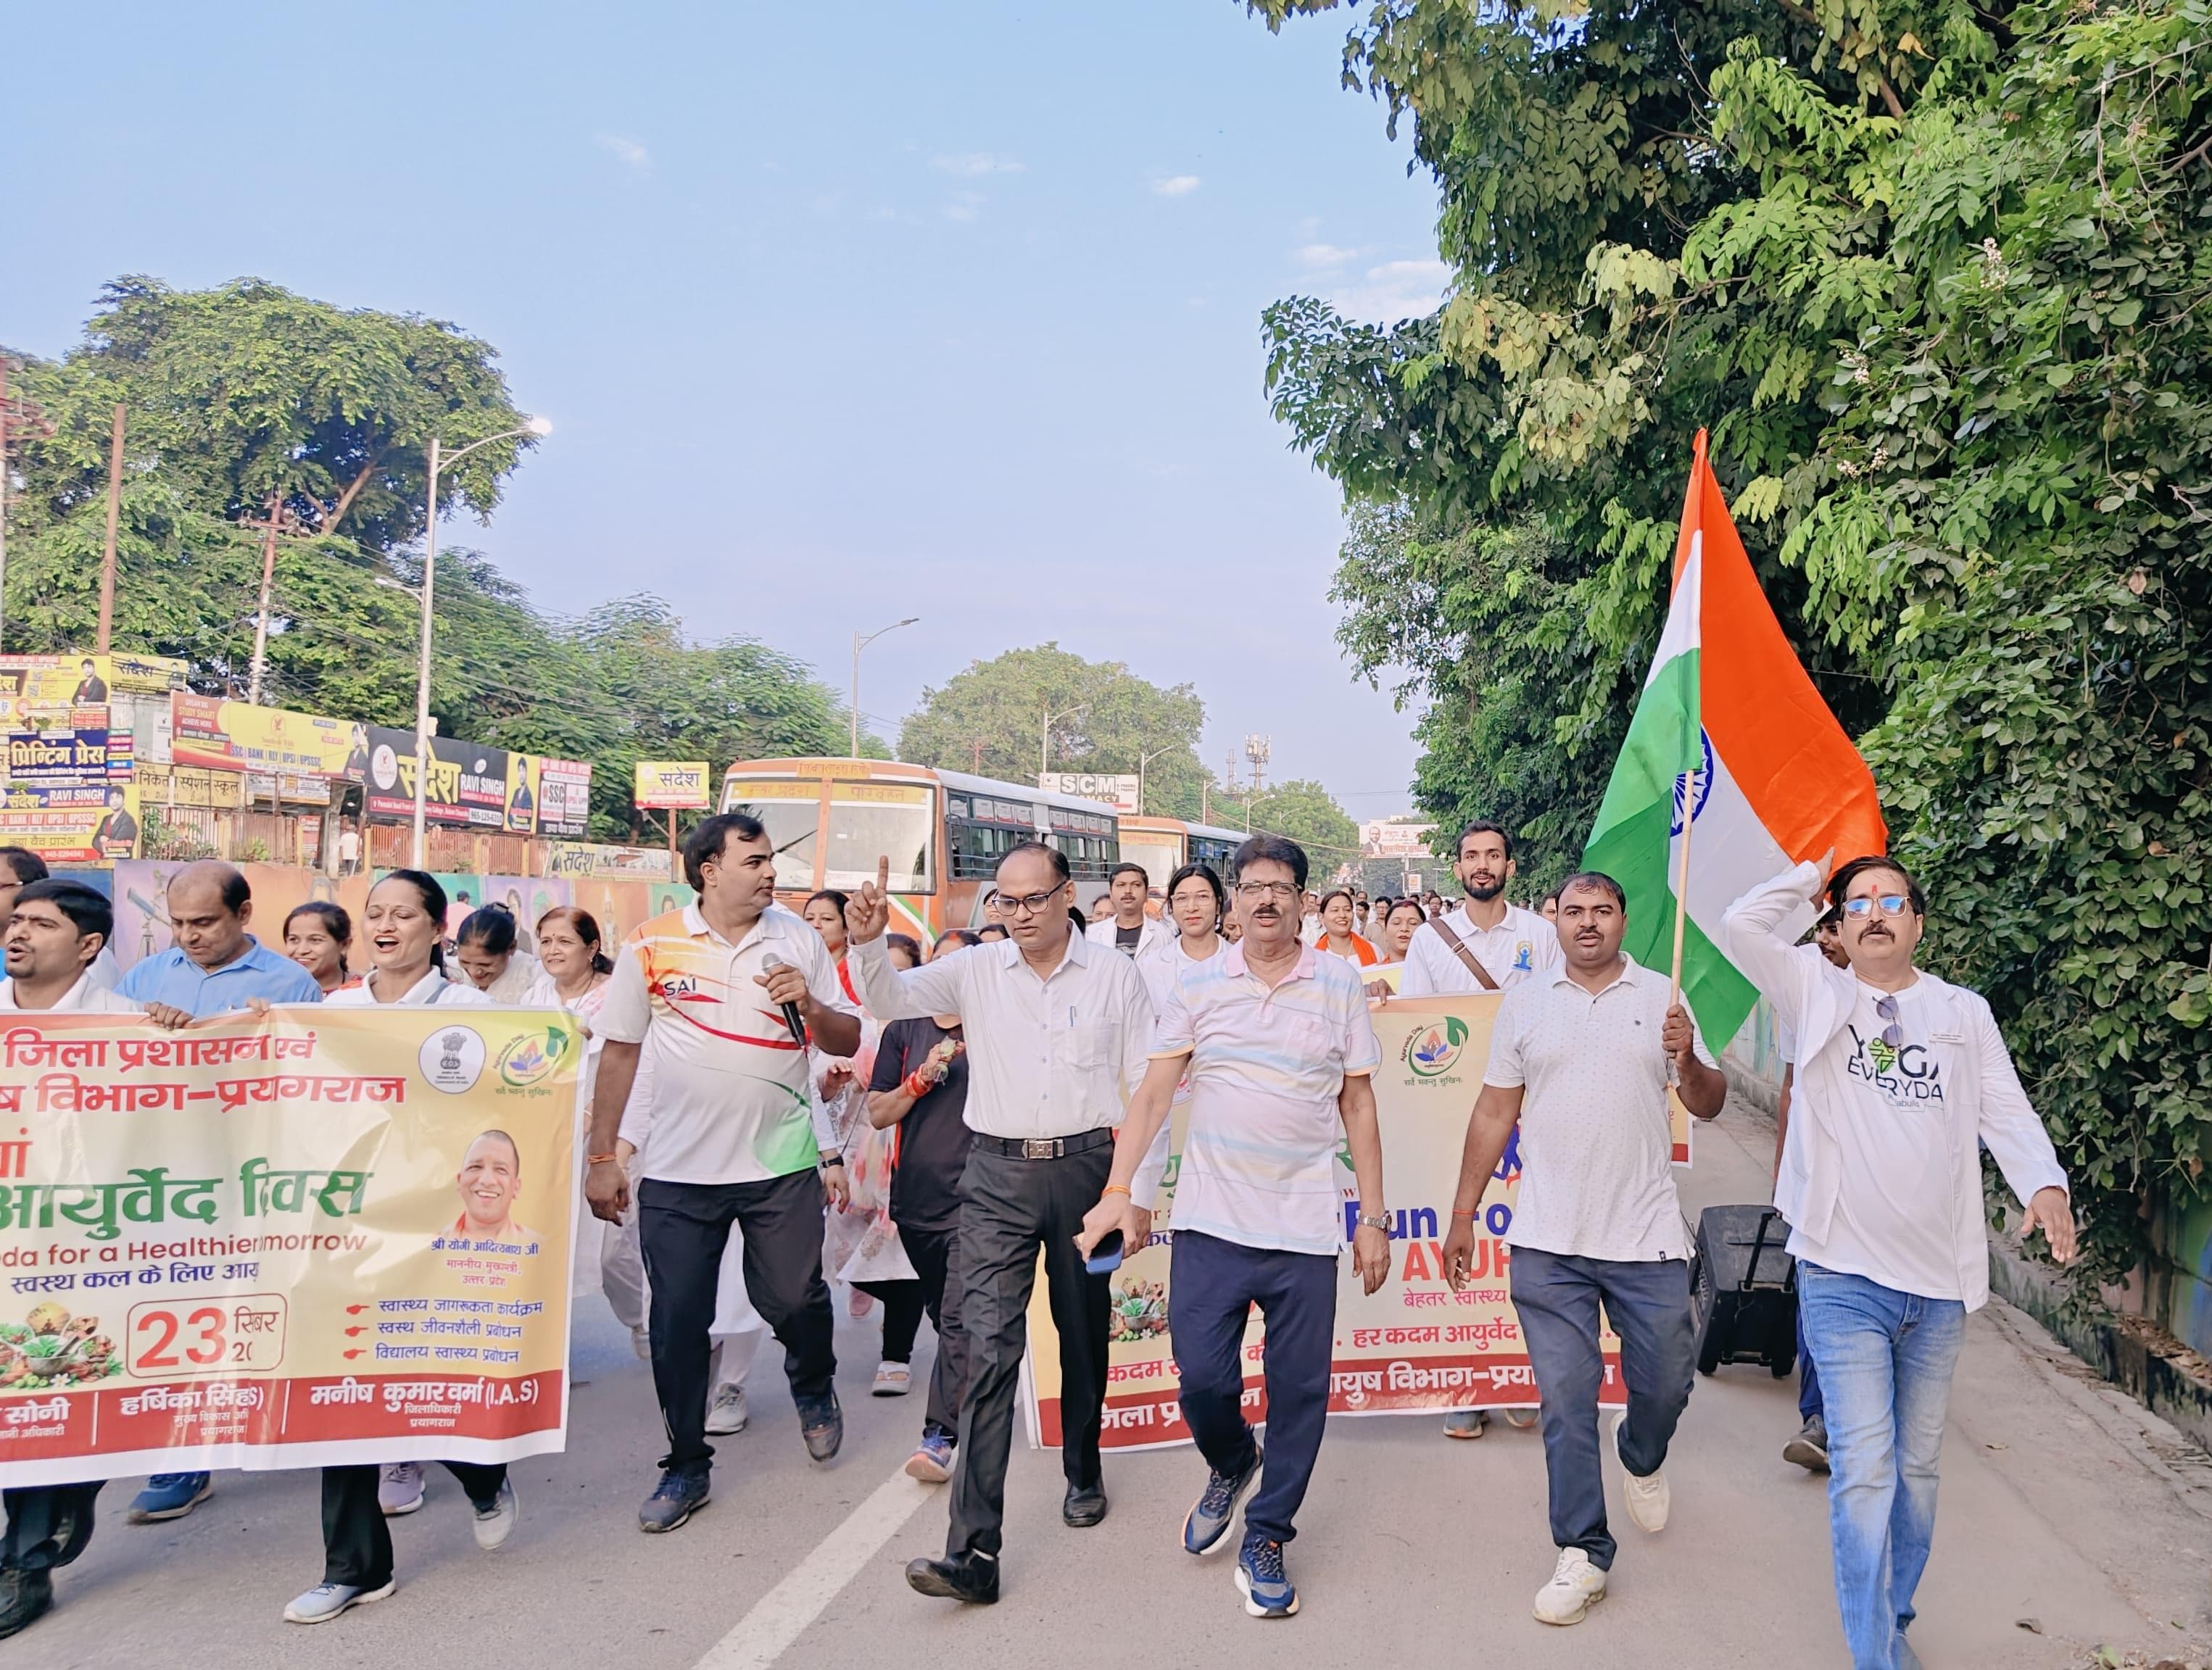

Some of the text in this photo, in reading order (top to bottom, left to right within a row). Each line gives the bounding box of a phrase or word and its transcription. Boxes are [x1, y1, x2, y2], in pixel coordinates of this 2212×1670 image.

[178, 707, 215, 720] STUDY SMART
[75, 739, 107, 765] प्रेस
[231, 745, 244, 757] SSC
[248, 747, 265, 760] BANK
[181, 773, 211, 791] स्पेशल
[214, 780, 239, 797] स्कूल
[460, 773, 505, 797] RAVI SINGH
[658, 766, 700, 787] संदेश
[1061, 775, 1115, 794] SCM
[49, 789, 105, 801] RAVI SINGH
[549, 784, 564, 803] SSC
[563, 846, 595, 873] संदेश
[664, 978, 696, 997] SAI
[4, 1027, 317, 1073] जिला प्रशासन एवं
[1847, 1055, 1944, 1102] EVERYDA
[49, 1243, 91, 1266] for
[99, 1245, 117, 1263] a
[128, 1234, 258, 1261] Healthier
[259, 1233, 368, 1252] morrow
[448, 1238, 471, 1251] योगी
[525, 1242, 539, 1255] जी
[447, 1258, 481, 1269] माननीय
[12, 1271, 76, 1295] स्वस्थ
[83, 1270, 131, 1289] कल
[138, 1265, 163, 1285] के
[170, 1262, 216, 1283] लिए
[378, 1298, 428, 1313] स्वास्थ्य
[434, 1299, 494, 1314] जागरूकता
[1404, 1287, 1507, 1308] बेहतर स्वास्थ्य
[376, 1321, 415, 1334] स्वस्थ
[421, 1317, 481, 1337] जीवनशैली
[1353, 1316, 1519, 1350] हर कदम आयुर्वेद
[136, 1307, 228, 1369] 23
[375, 1342, 428, 1360] विद्यालय
[434, 1346, 479, 1360] स्वास्थ्य
[1106, 1360, 1164, 1383] कदम
[120, 1387, 203, 1416] हर्षिका
[310, 1376, 539, 1413] मनीष कुमार वर्मा (I.A.S)
[6, 1395, 72, 1424] सोनी
[404, 1403, 462, 1416] जिलाधिकारी
[22, 1424, 65, 1439] अधिकारी
[410, 1418, 456, 1429] प्रयागराज
